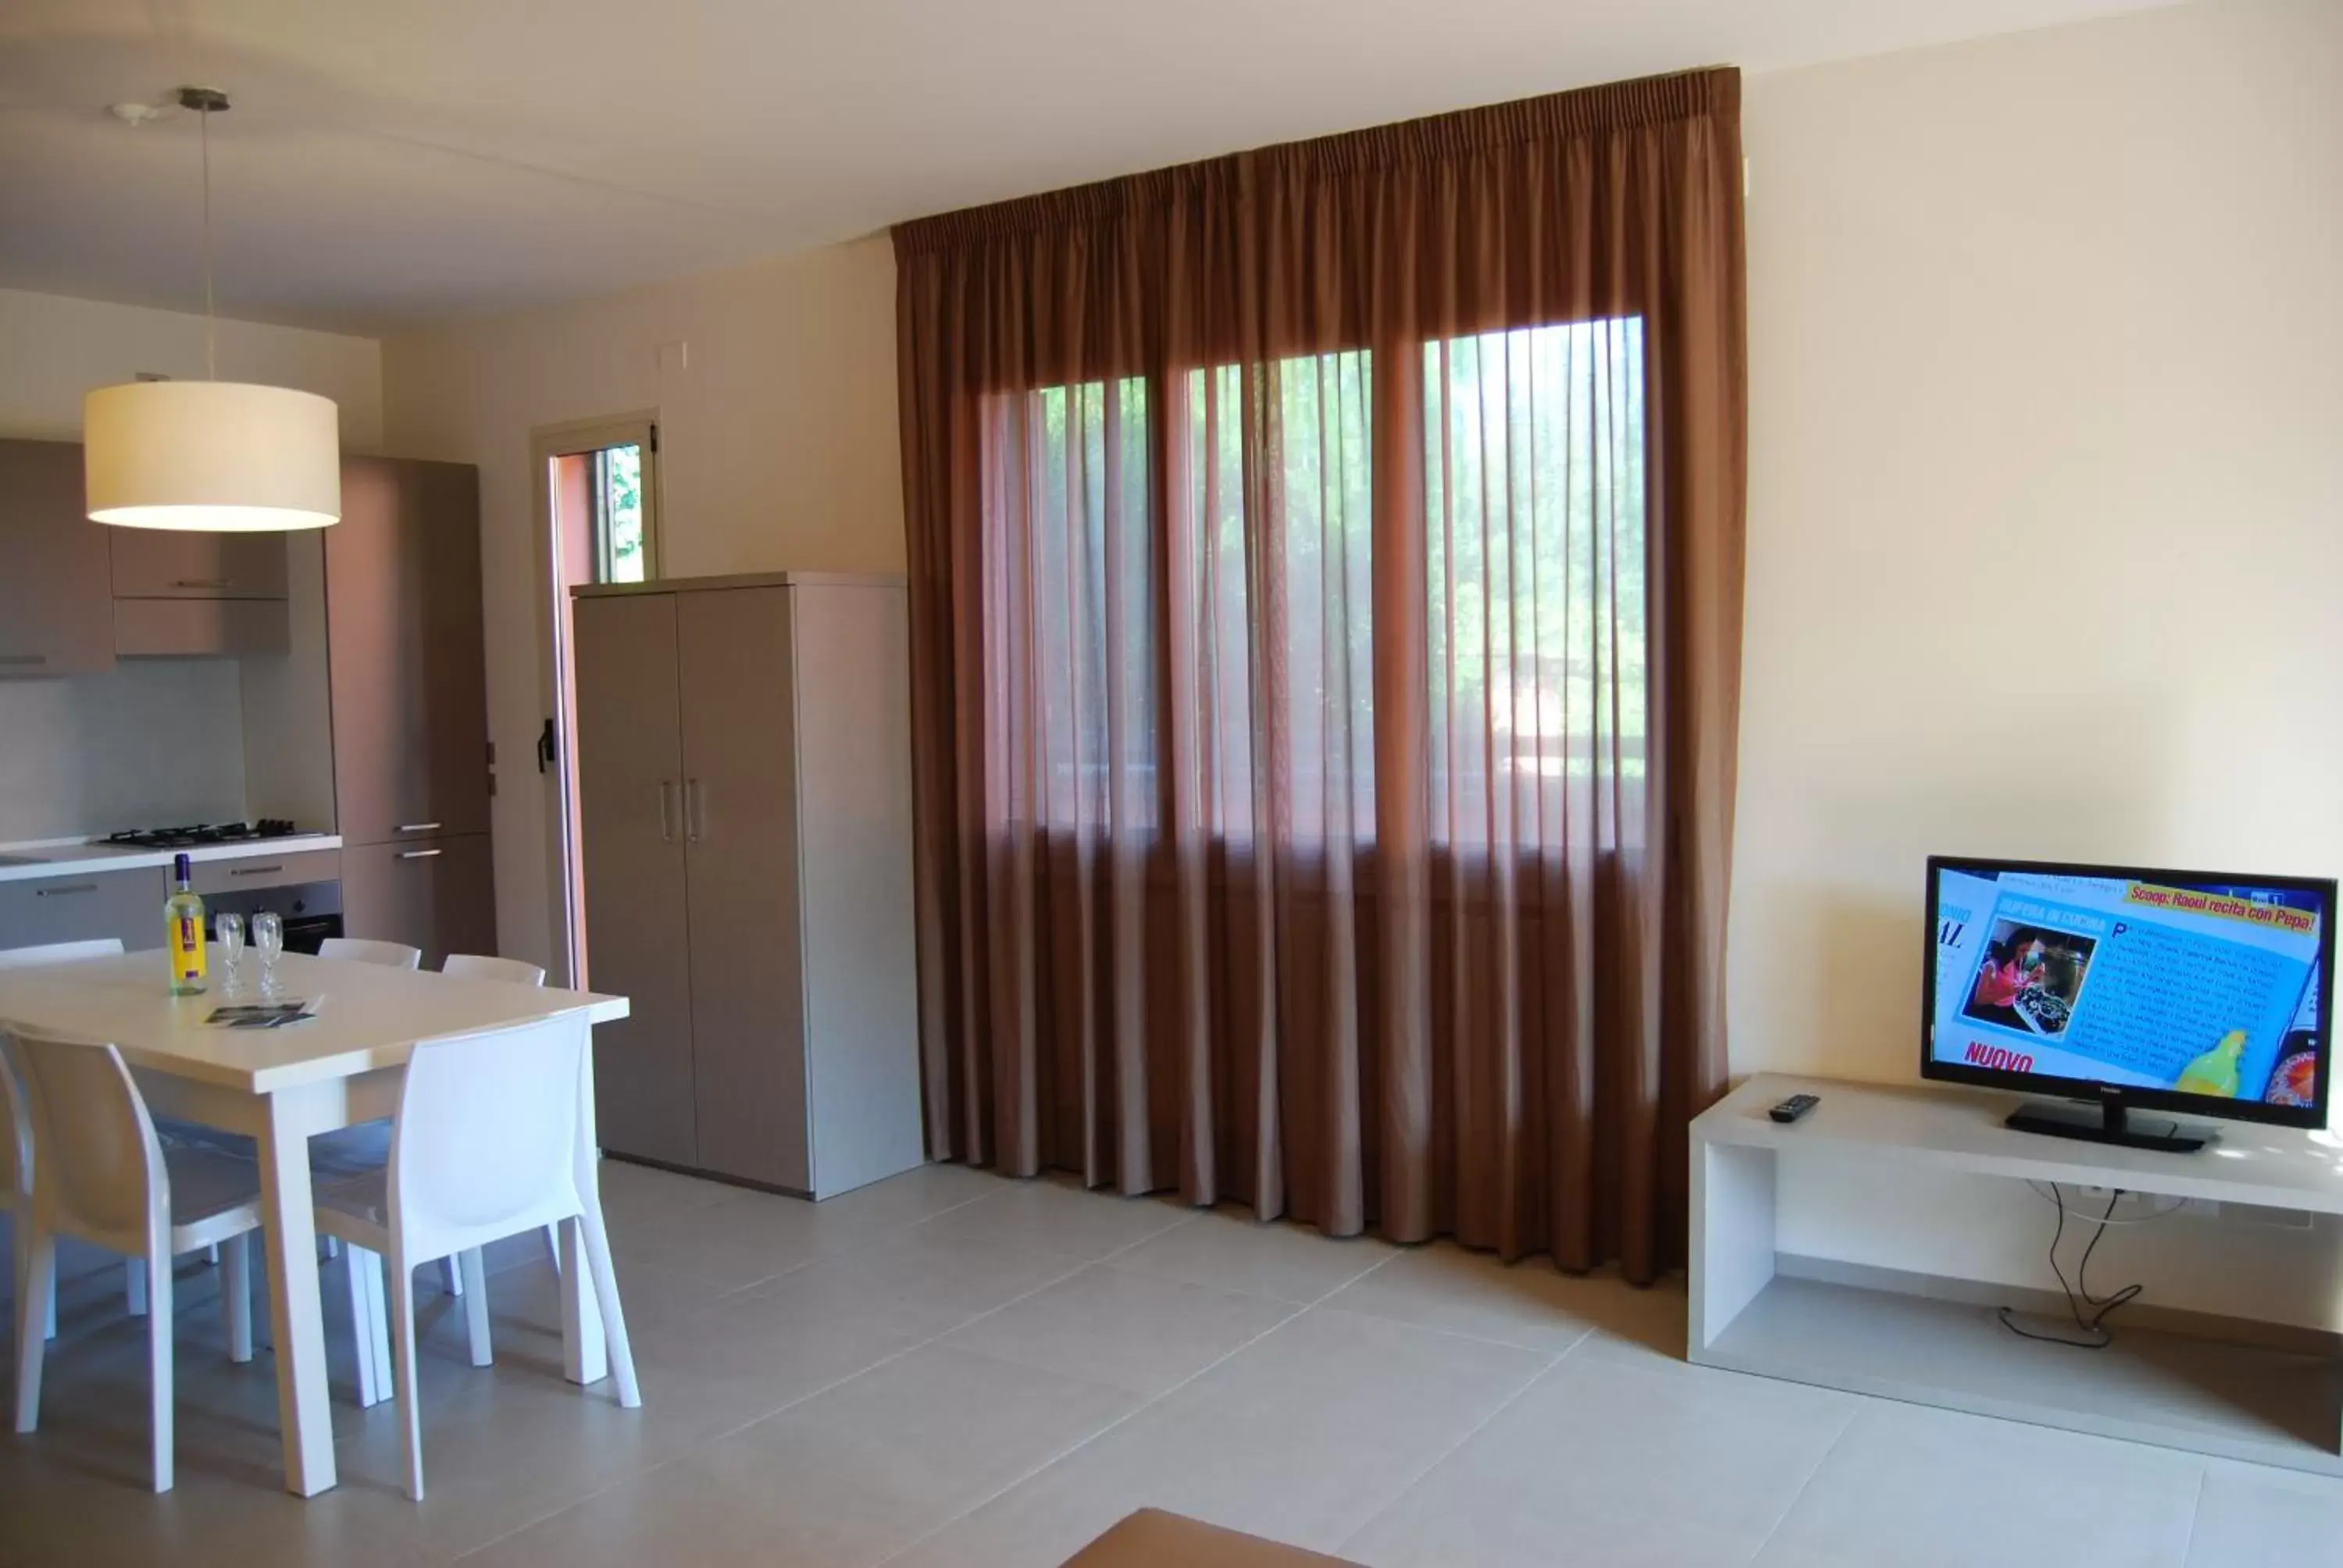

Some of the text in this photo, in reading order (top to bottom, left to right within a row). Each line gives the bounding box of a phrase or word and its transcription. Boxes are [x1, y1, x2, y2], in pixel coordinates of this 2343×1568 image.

[2131, 886, 2170, 906] Scoop:
[2172, 891, 2207, 911] Raoul
[2209, 898, 2245, 917] recita
[2247, 907, 2272, 923] con
[2274, 909, 2316, 932] Pepa!
[1964, 1041, 2034, 1073] NUOVO
